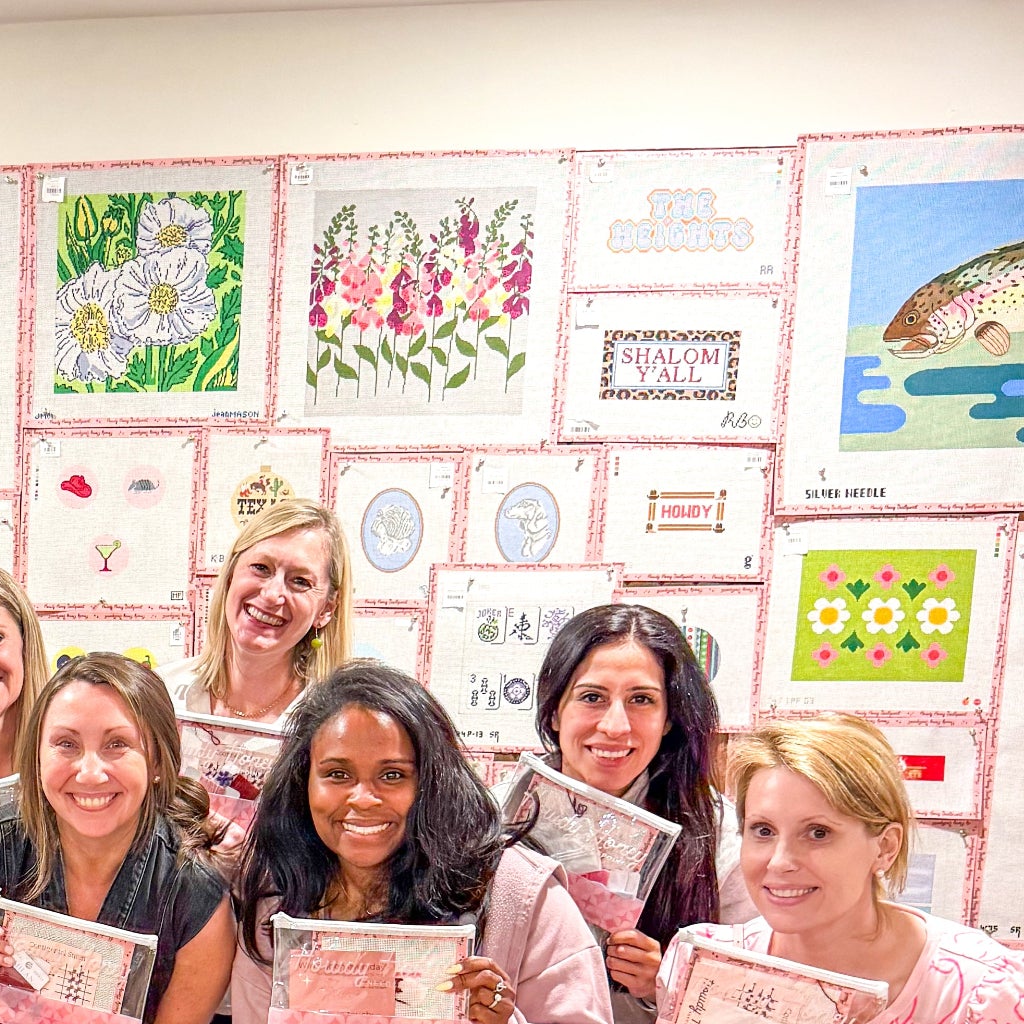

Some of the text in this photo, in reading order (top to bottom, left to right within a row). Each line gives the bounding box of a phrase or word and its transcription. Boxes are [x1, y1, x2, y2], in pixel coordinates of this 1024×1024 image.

[649, 190, 715, 219] THE
[609, 221, 752, 249] HEIGHTS
[621, 347, 720, 365] SHALOM
[635, 366, 703, 383] Y'ALL
[805, 487, 887, 499] SILVER NEEDLE
[237, 498, 290, 515] TEX
[661, 504, 713, 519] HOWDY
